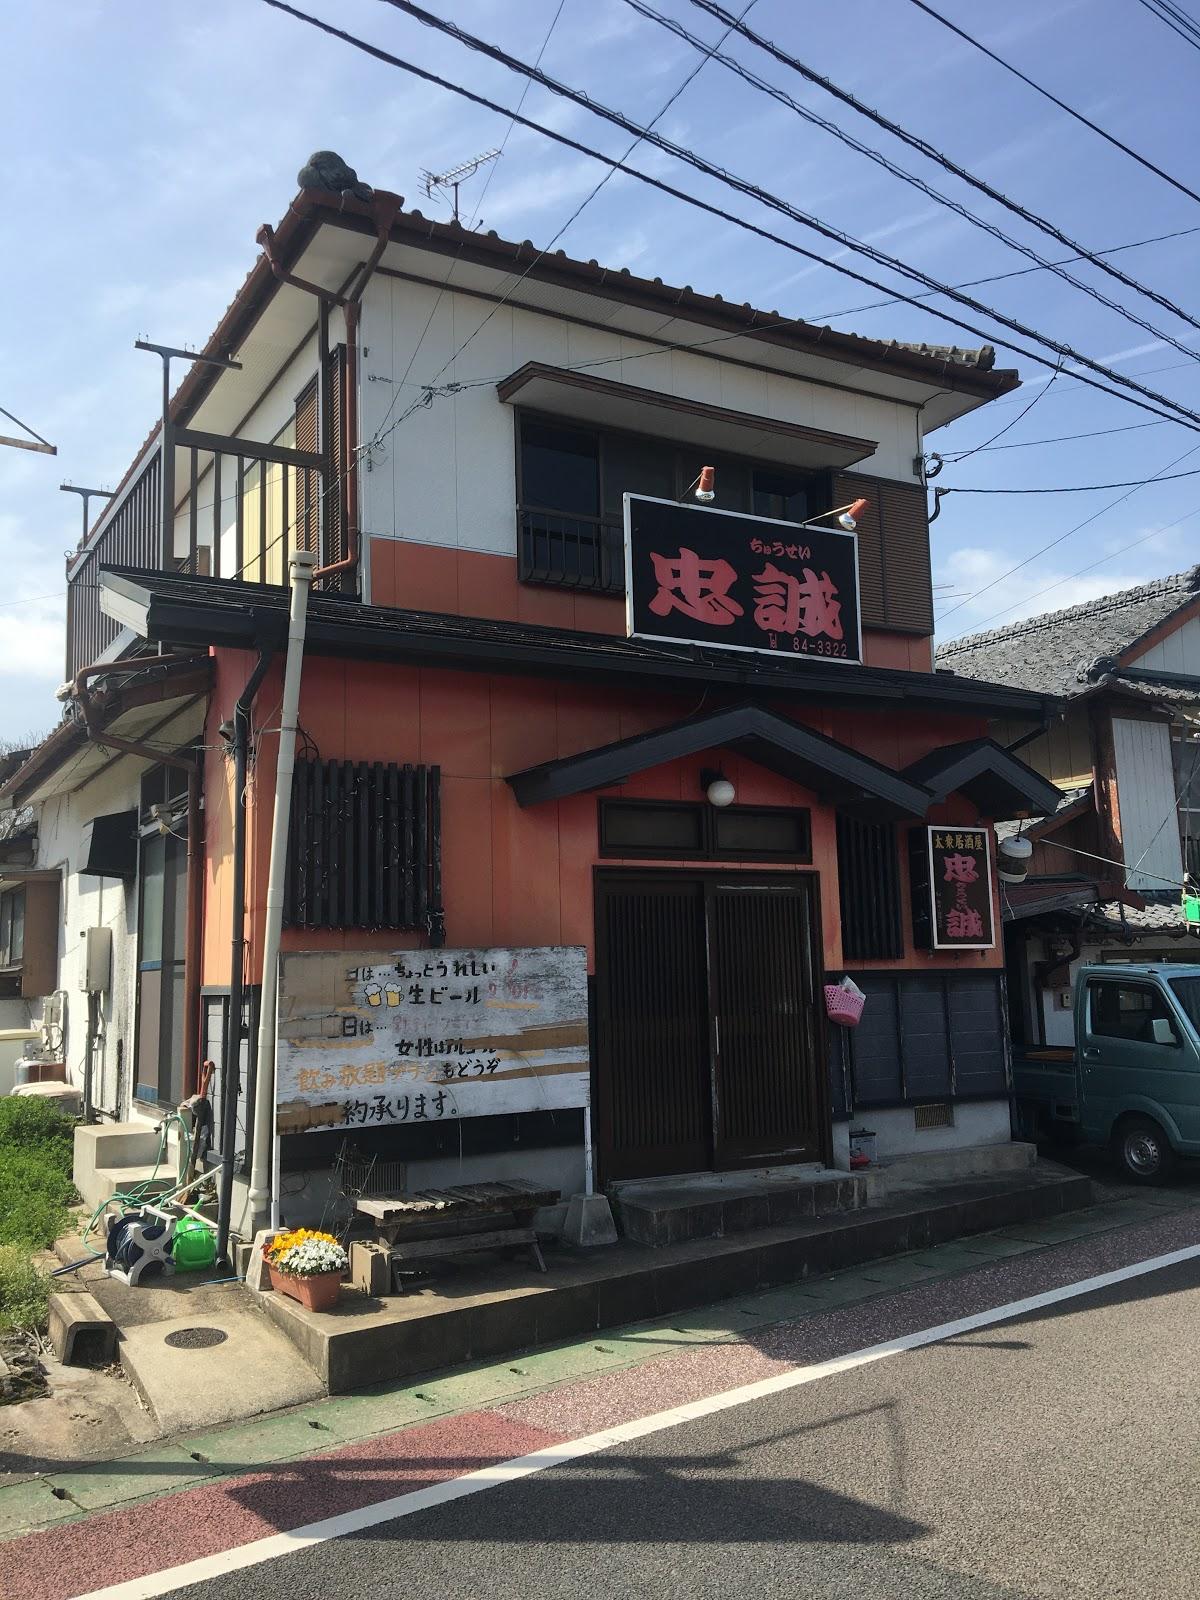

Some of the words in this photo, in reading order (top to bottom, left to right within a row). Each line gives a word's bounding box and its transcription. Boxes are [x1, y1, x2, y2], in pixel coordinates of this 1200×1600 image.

[750, 537, 811, 560] ちゅうせい
[649, 547, 844, 640] 忠誠
[793, 637, 847, 657] 84-3322
[408, 984, 482, 1005] 生ビール
